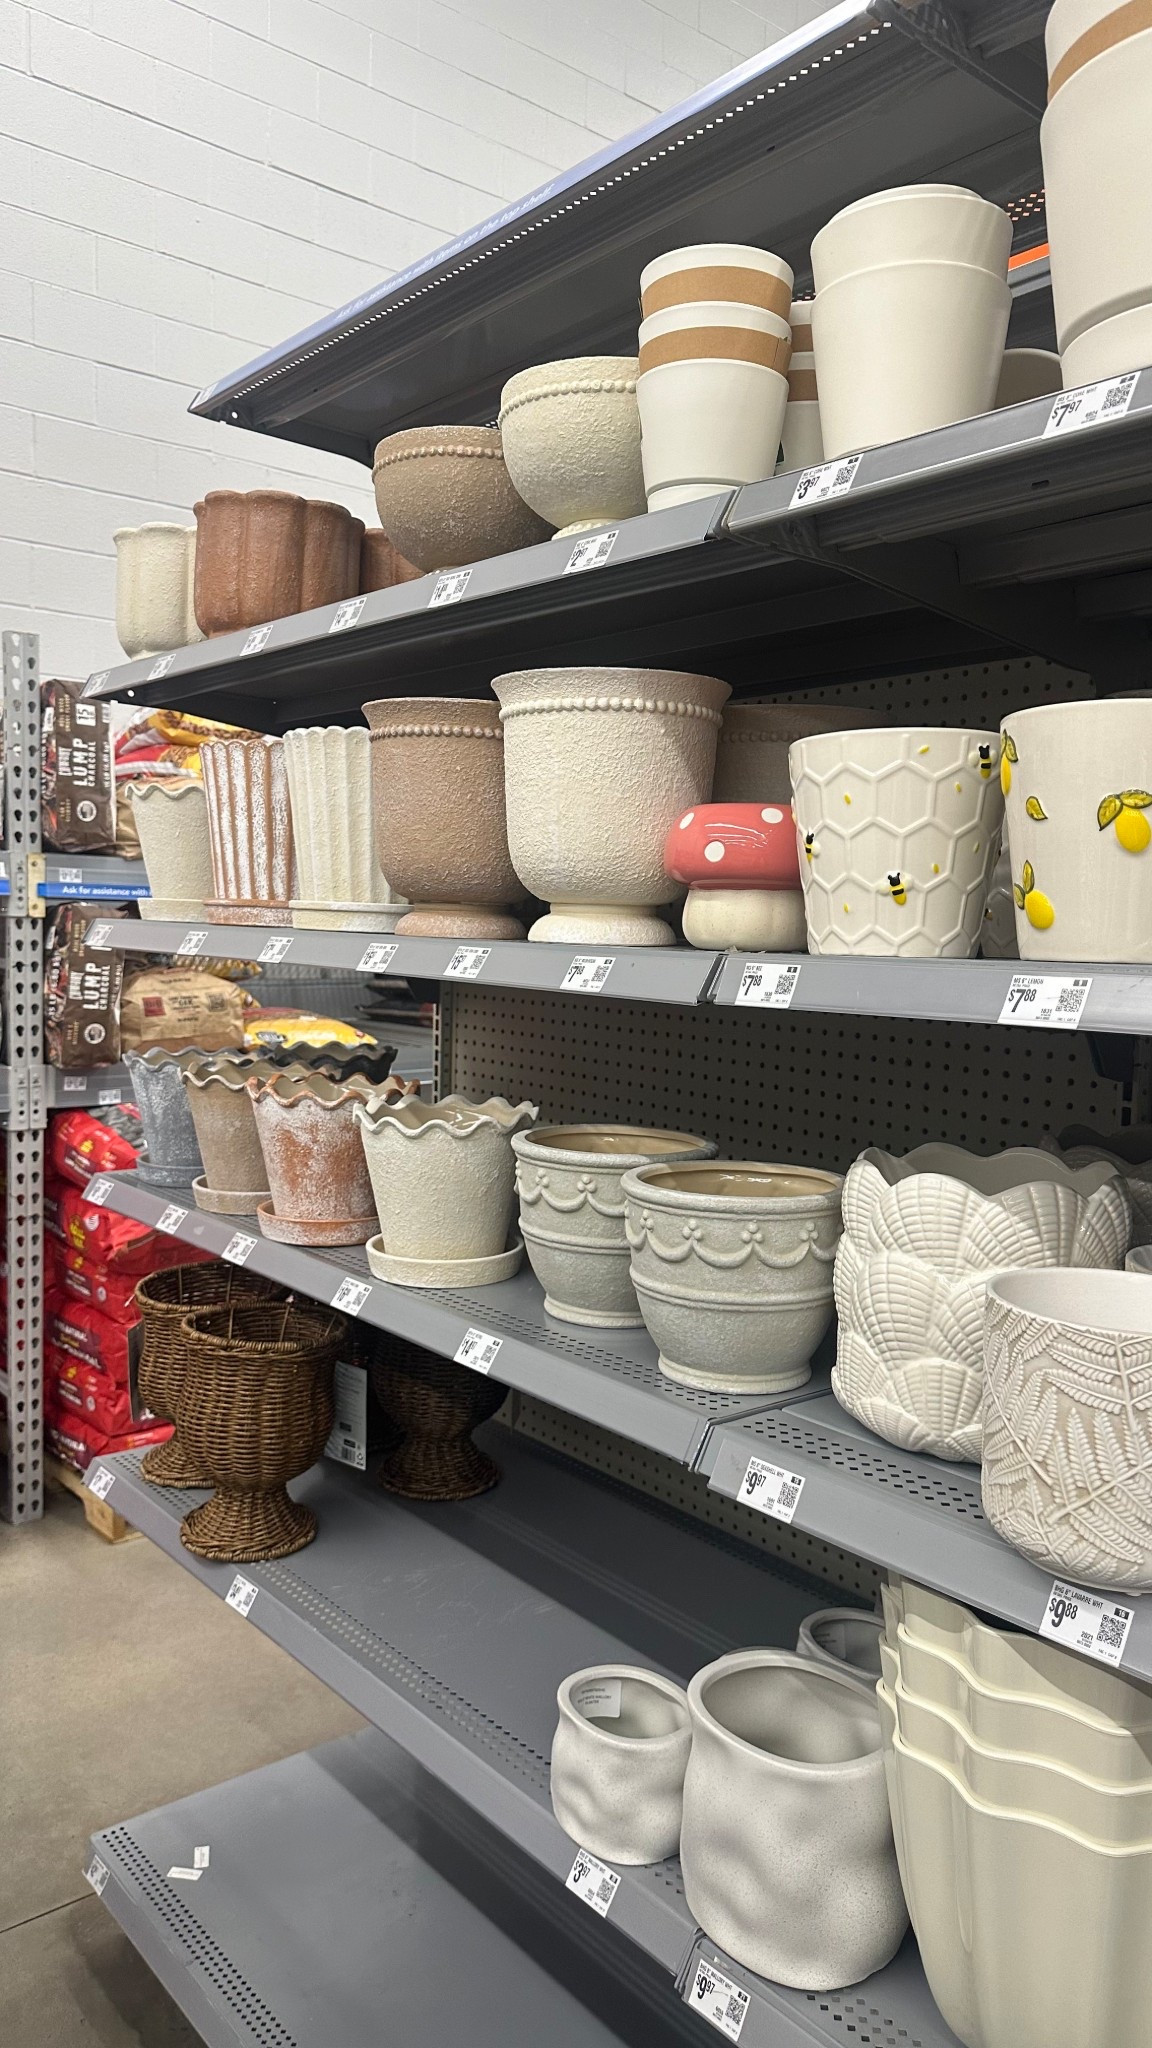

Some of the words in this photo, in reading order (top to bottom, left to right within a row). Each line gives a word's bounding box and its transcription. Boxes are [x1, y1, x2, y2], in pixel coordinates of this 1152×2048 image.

[480, 219, 499, 235] the
[500, 206, 520, 223] top
[72, 738, 89, 786] LUMP
[88, 741, 96, 787] CHARCOAL
[62, 886, 78, 894] Ask
[79, 886, 91, 895] for
[92, 887, 130, 896] assistance
[131, 888, 149, 896] with
[83, 963, 101, 1009] LUMP
[100, 965, 110, 1010] CHARCOAL
[1055, 1585, 1064, 1594] BHG
[1092, 1600, 1103, 1609] WHT
